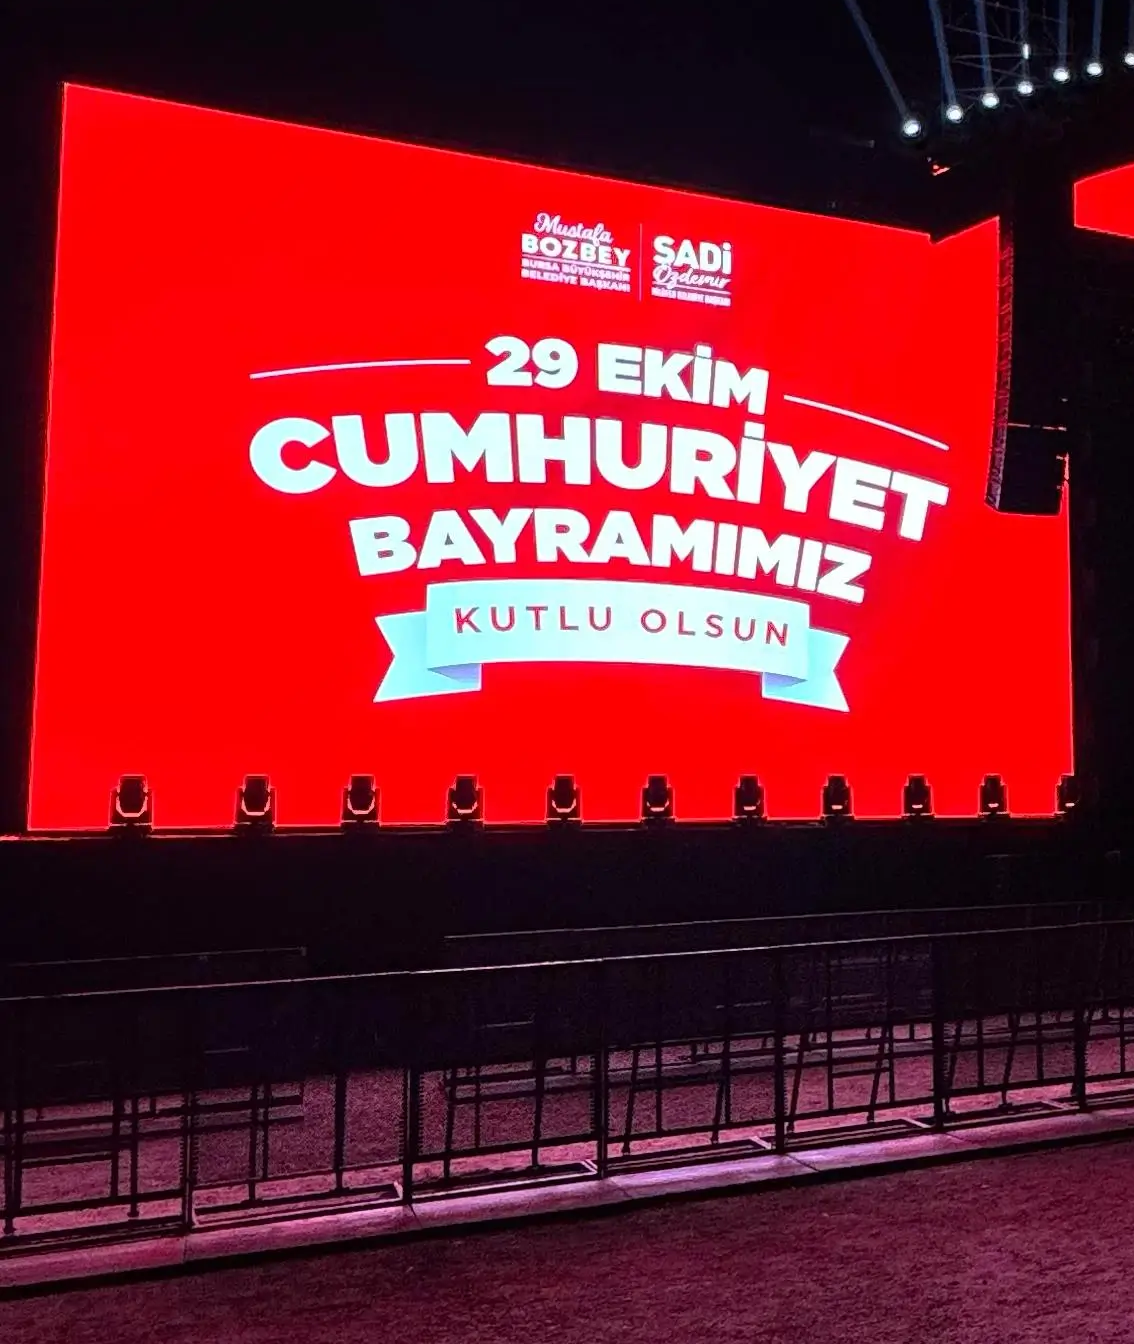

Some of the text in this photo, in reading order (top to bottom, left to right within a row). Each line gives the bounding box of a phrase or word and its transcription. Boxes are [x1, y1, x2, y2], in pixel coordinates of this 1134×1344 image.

[521, 233, 631, 267] BOZBEY
[534, 212, 614, 247] Mustafa
[485, 336, 769, 415] 29 EKİM
[250, 413, 949, 541] CUMHURİYET
[349, 508, 872, 603] BAYRAMIMIZ
[455, 606, 788, 646] KUTLU OLSUN
